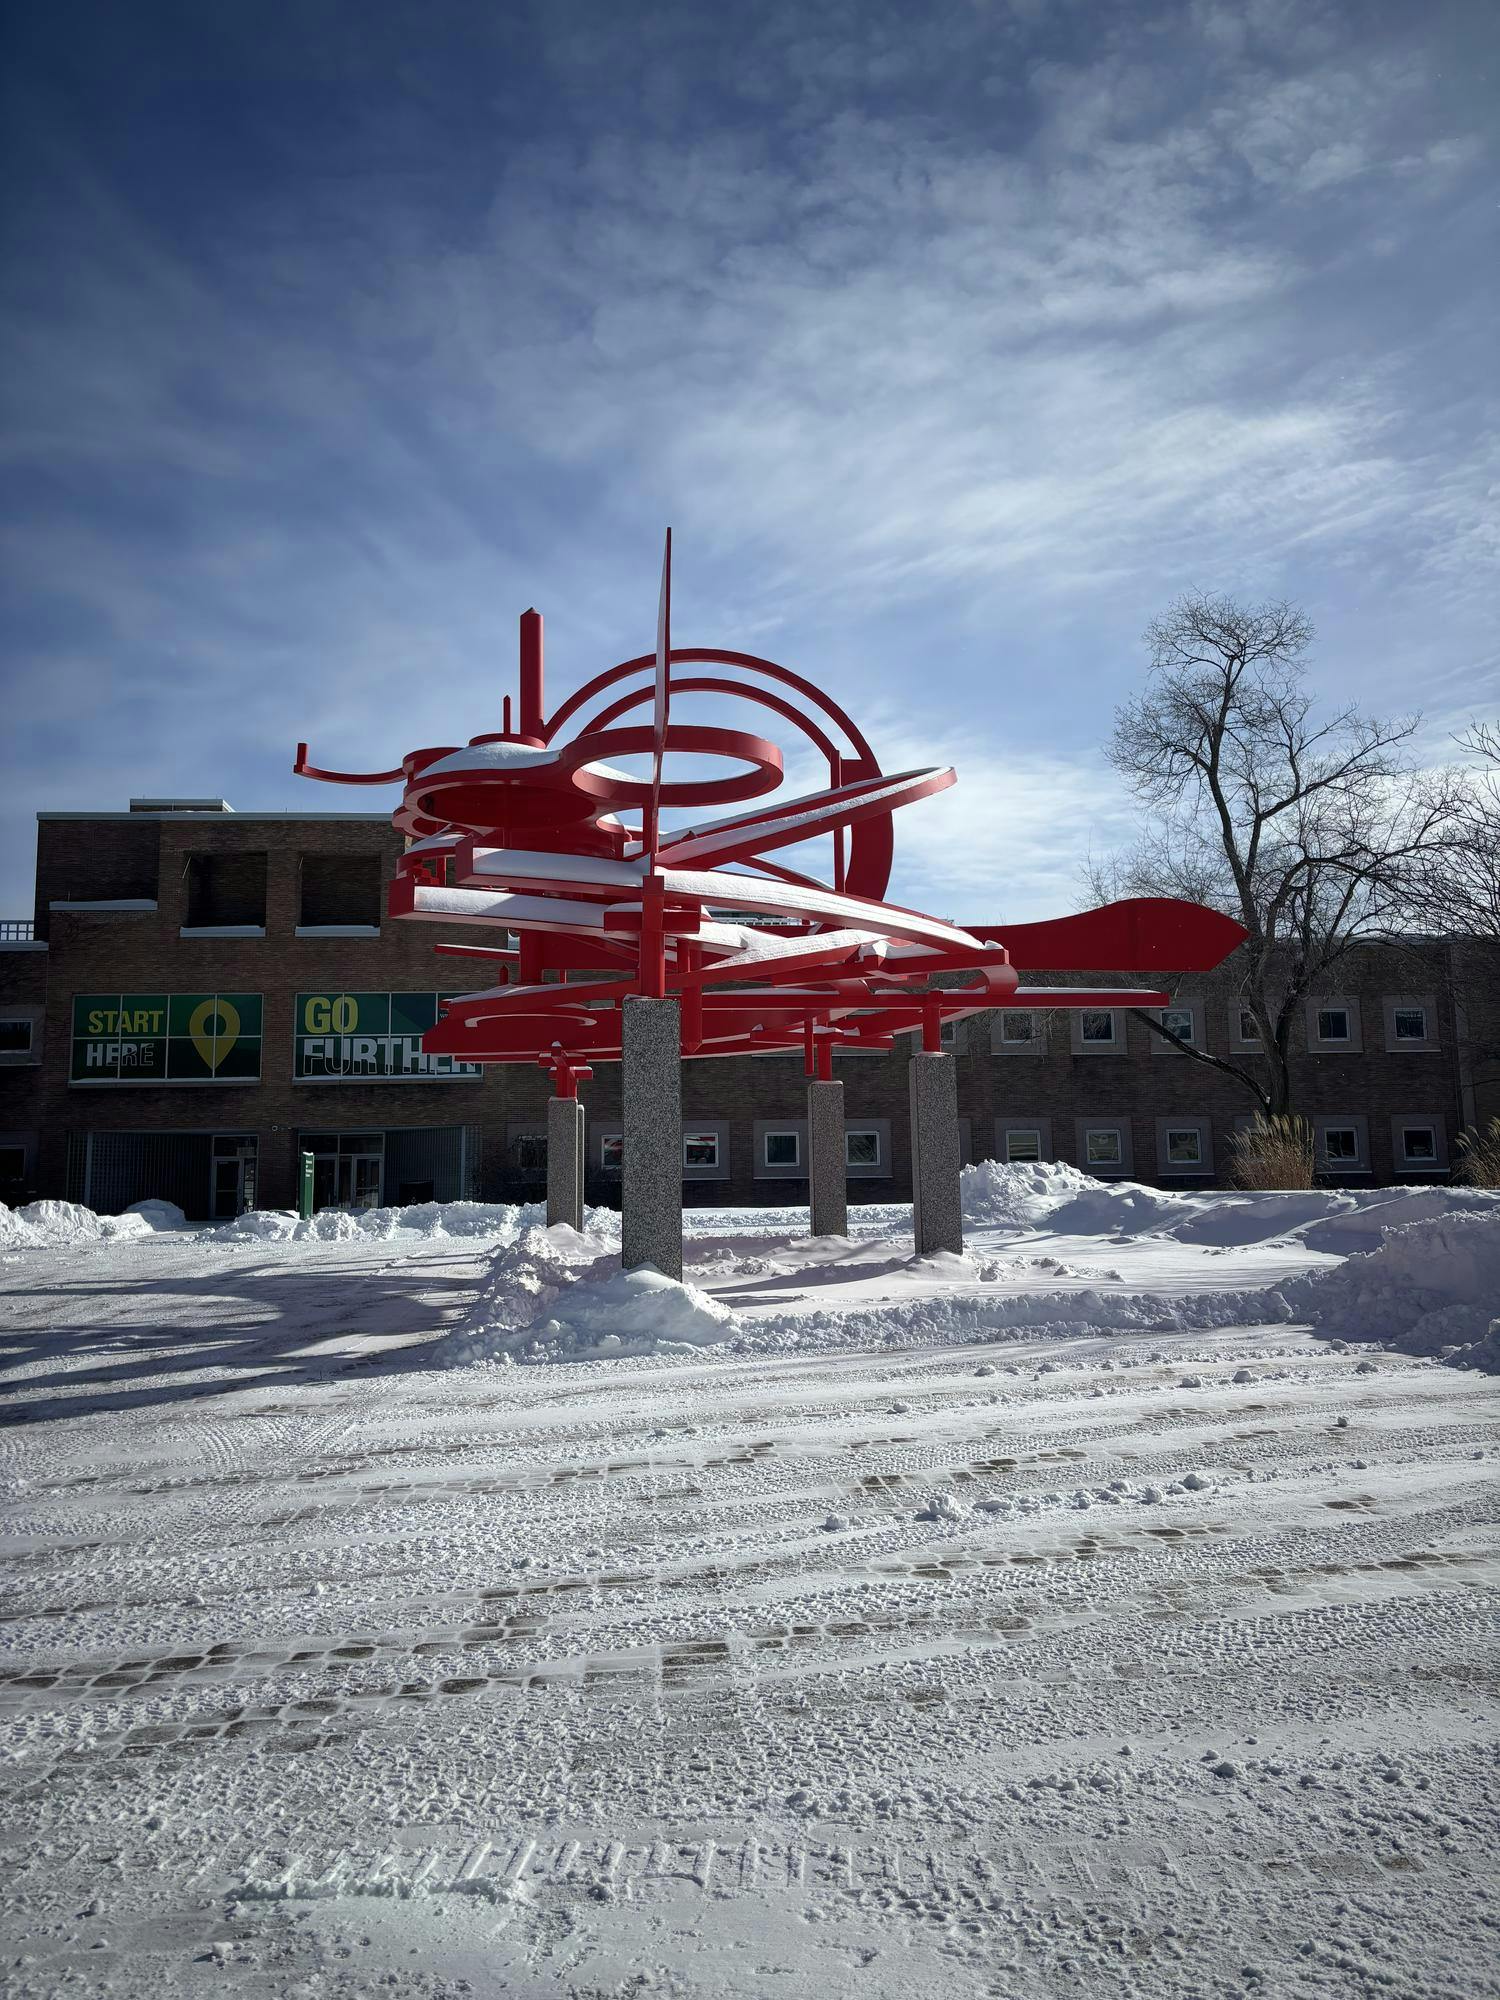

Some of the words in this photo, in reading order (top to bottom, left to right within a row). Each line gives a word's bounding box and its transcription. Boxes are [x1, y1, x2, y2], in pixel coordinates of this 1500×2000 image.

[88, 1010, 164, 1033] START
[305, 996, 358, 1034] GO
[86, 1042, 154, 1067] HERE
